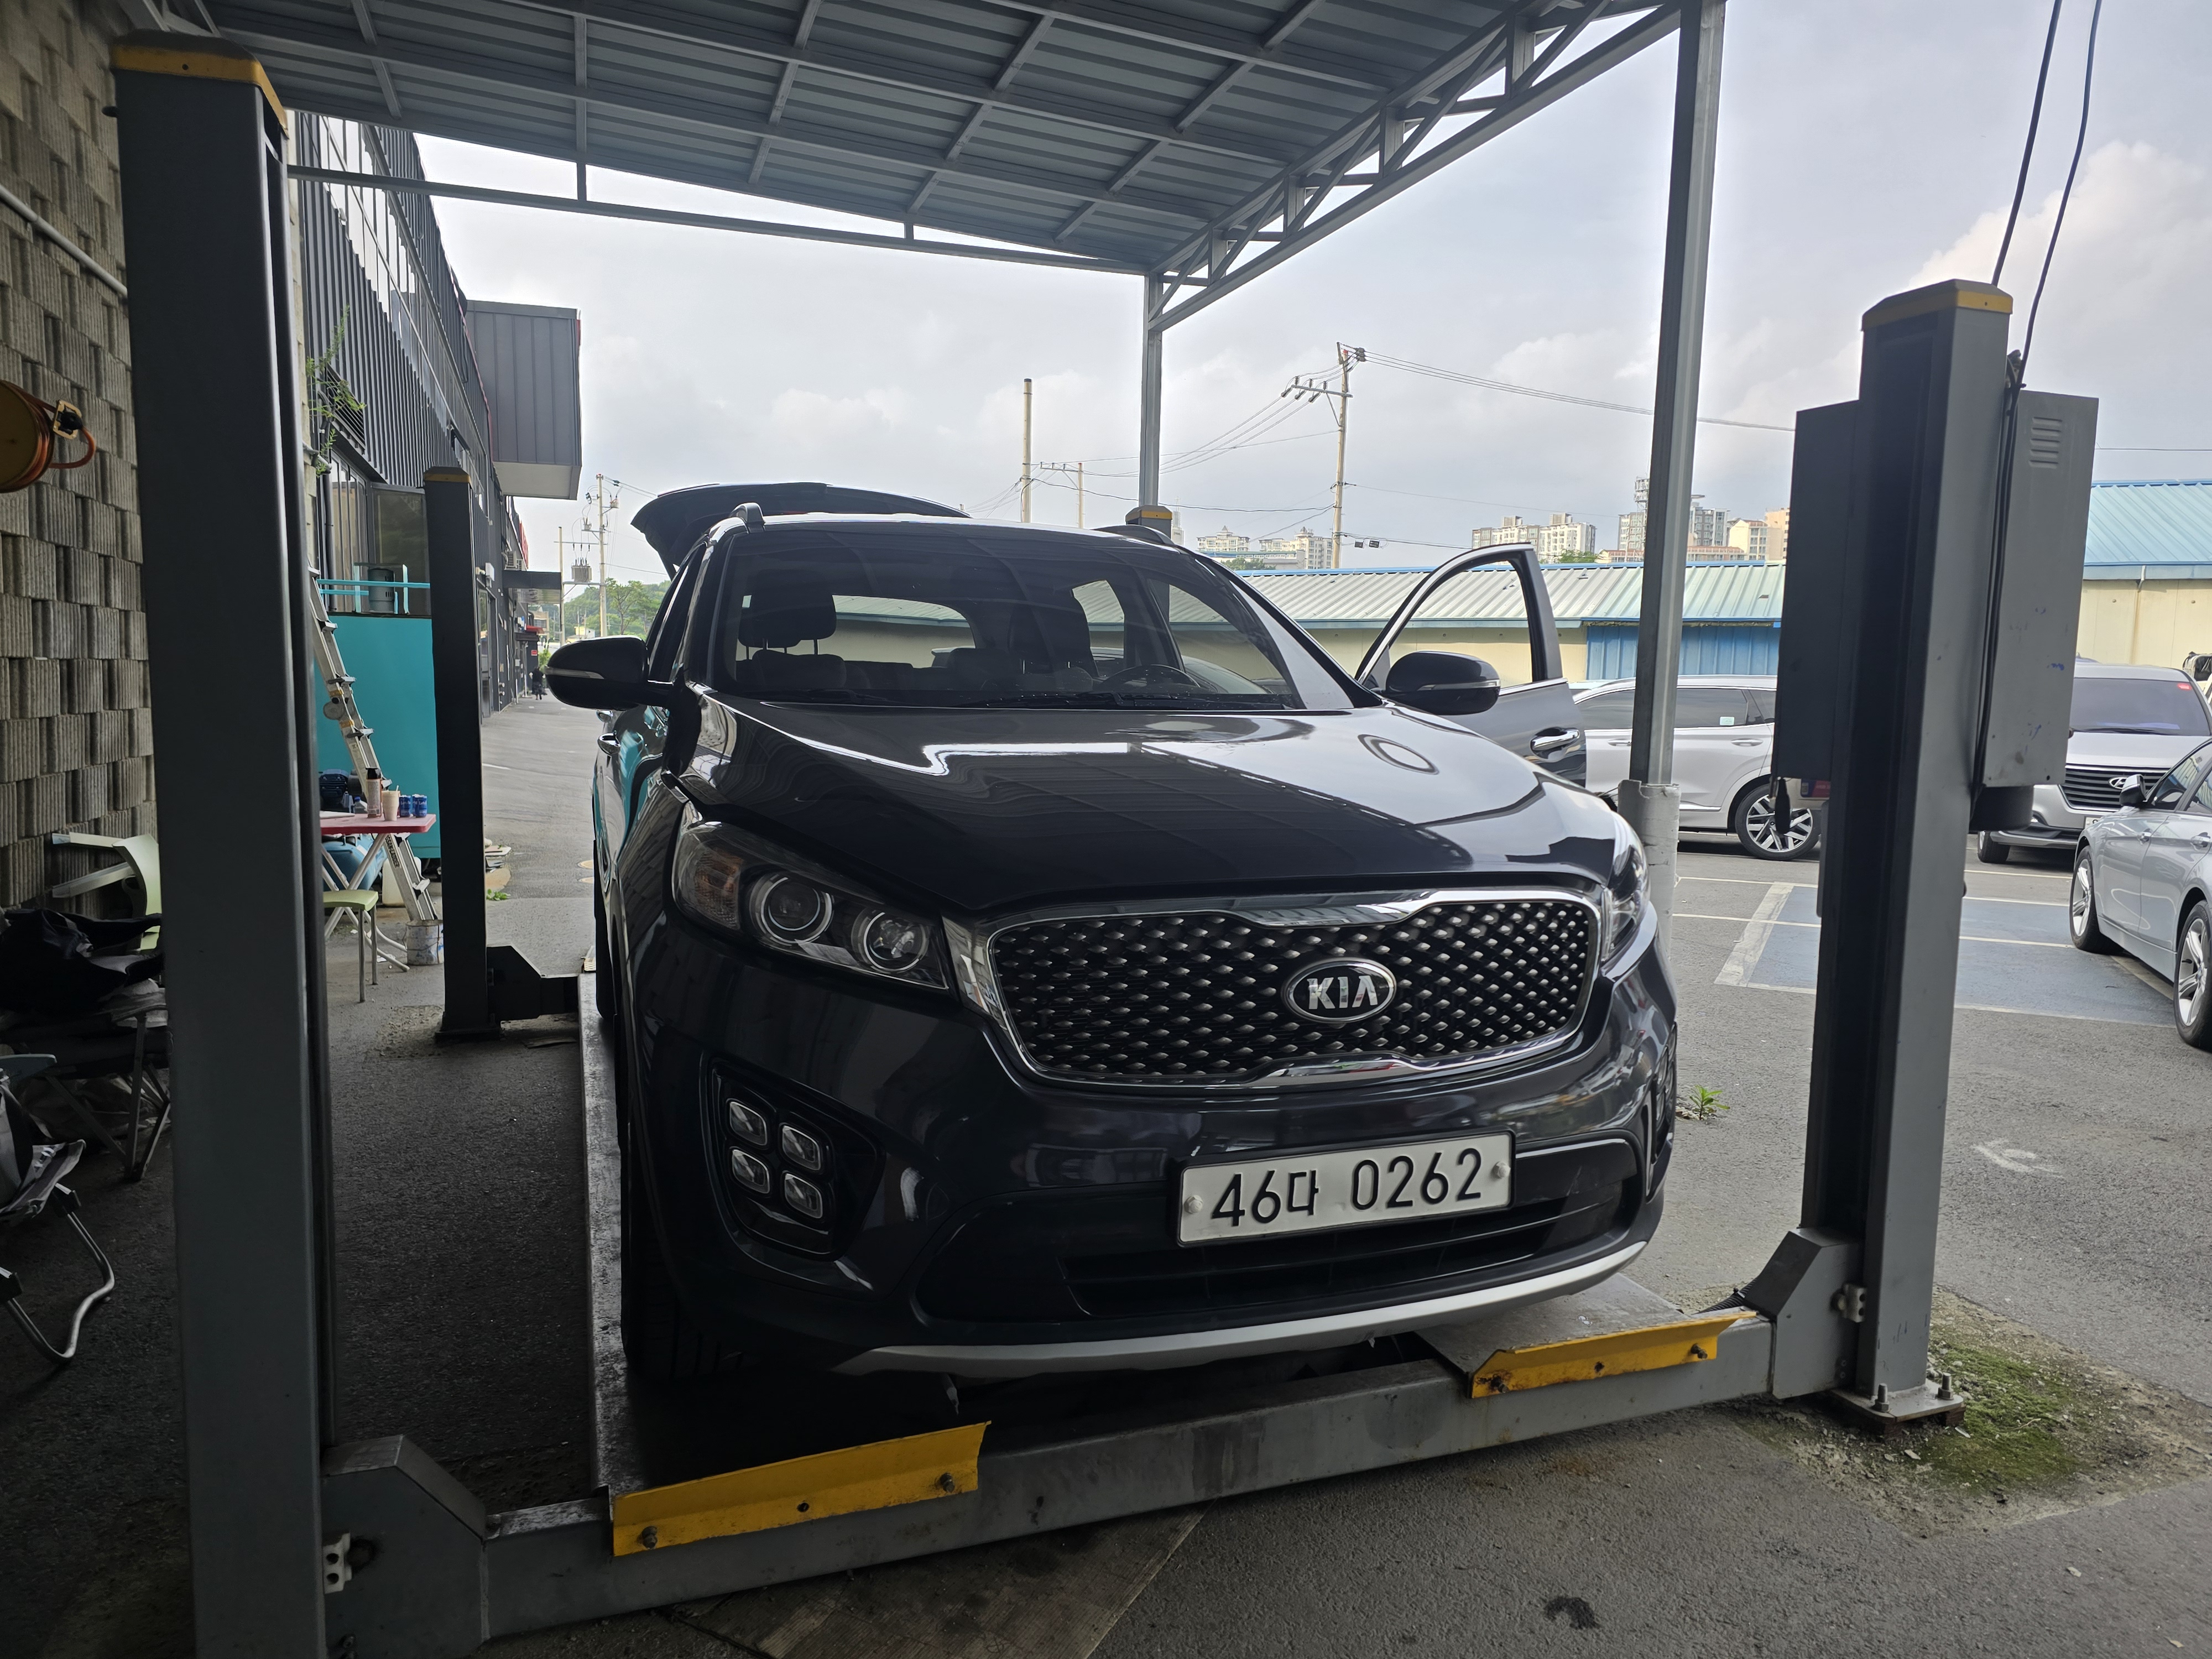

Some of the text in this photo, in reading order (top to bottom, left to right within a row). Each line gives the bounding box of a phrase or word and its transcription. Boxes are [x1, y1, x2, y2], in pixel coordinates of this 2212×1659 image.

[1307, 975, 1378, 1010] KIA
[1211, 1147, 1481, 1227] 46다 0262
